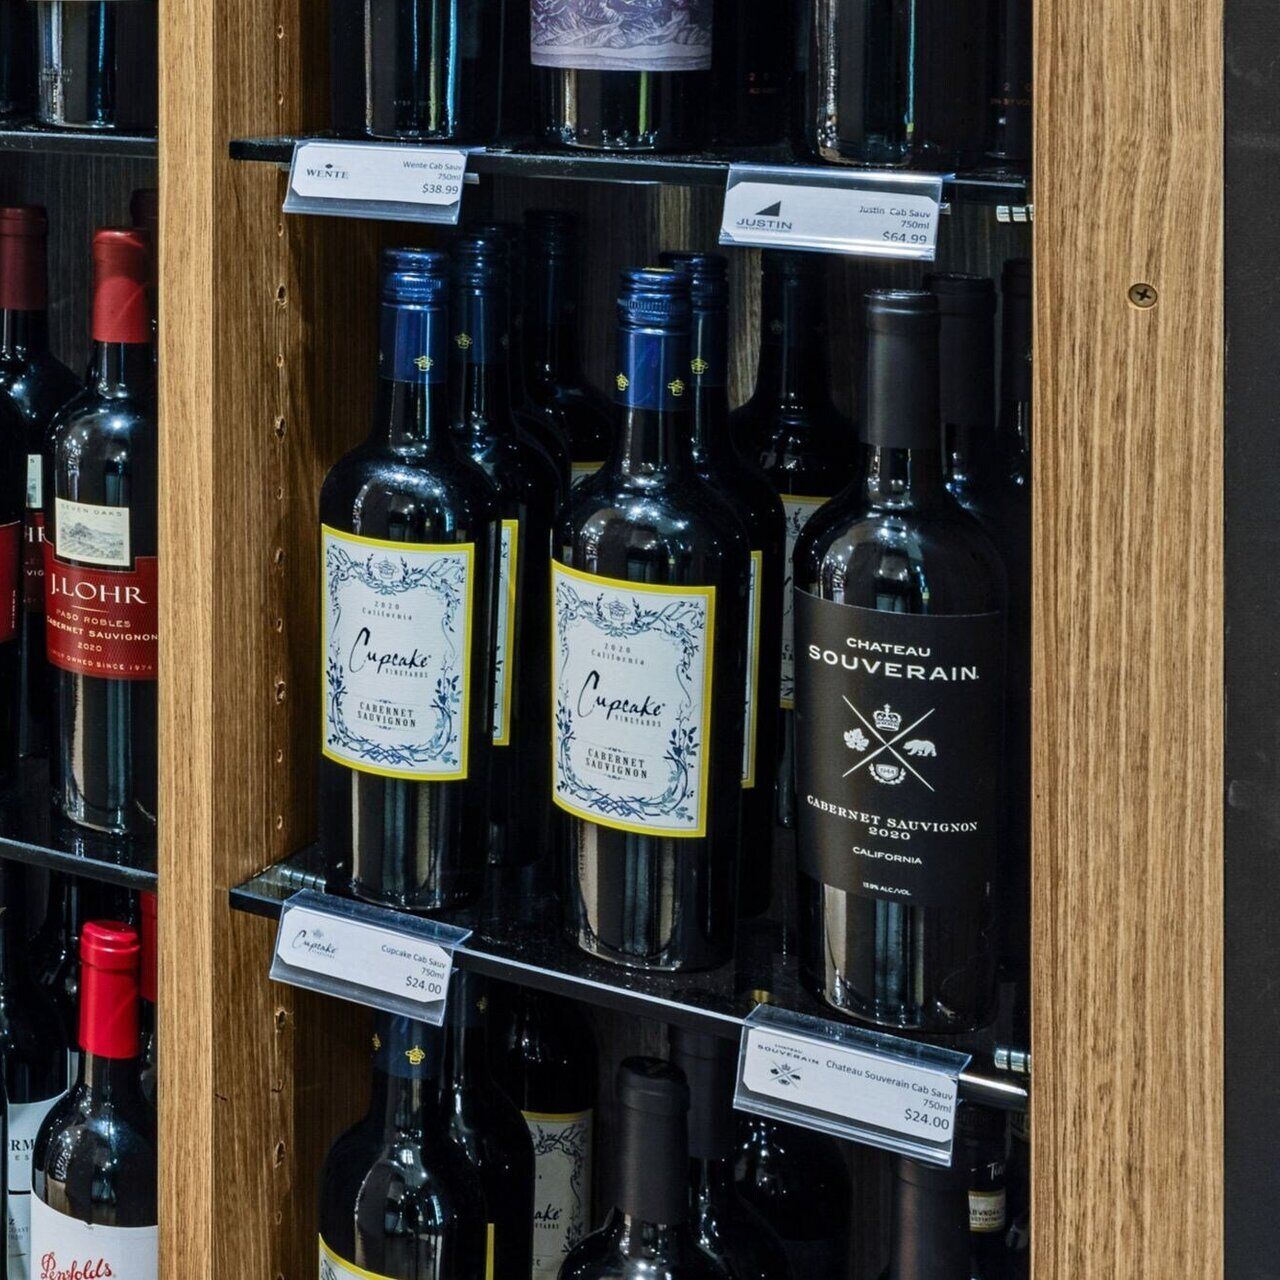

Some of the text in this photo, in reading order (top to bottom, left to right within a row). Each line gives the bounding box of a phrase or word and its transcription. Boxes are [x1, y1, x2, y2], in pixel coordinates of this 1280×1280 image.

[306, 169, 349, 179] WENTE
[422, 184, 458, 195] $38.99
[736, 218, 792, 230] JUSTIN
[883, 231, 927, 244] $64.99
[51, 574, 147, 604] J.LOHR
[348, 626, 432, 674] Cupcake
[846, 637, 931, 657] CHATEAU
[809, 645, 977, 681] SOUVERAIN
[577, 670, 666, 717] Cupcake
[807, 795, 978, 833] CABERNET SAUVIGNON
[868, 826, 911, 840] 2020
[853, 847, 922, 864] CALIFORNIA
[382, 944, 412, 961] Cupcake
[406, 976, 442, 995] $24.00
[826, 1059, 953, 1101] Chateau Souverain Cab Sauv
[904, 1108, 950, 1130] $24.00
